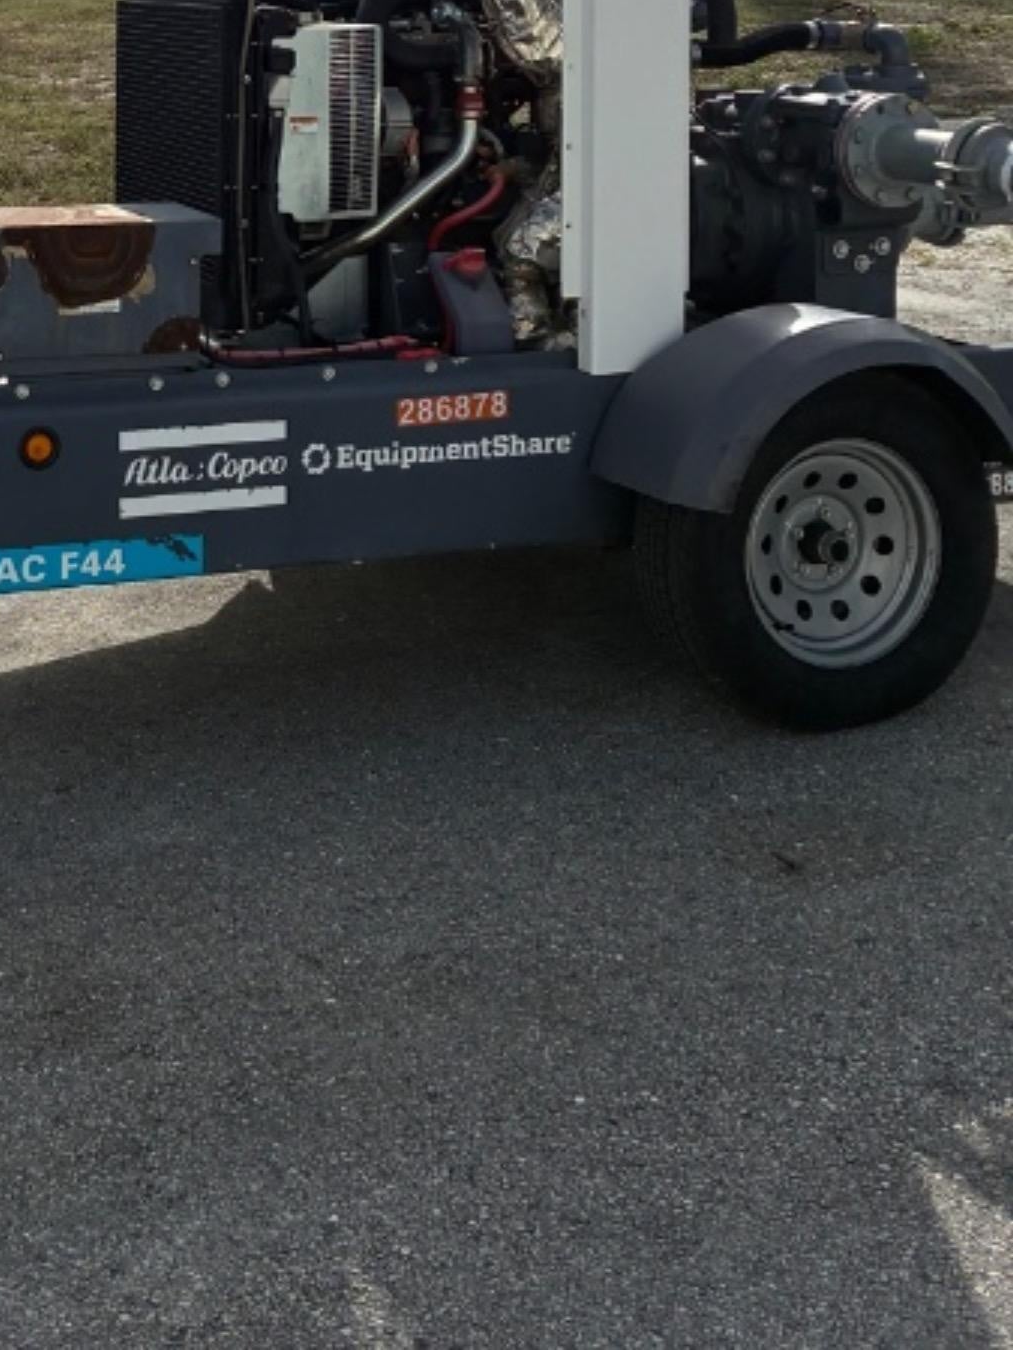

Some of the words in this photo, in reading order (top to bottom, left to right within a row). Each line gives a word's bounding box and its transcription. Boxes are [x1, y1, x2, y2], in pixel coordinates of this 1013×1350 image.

[397, 390, 508, 426] 286878
[207, 451, 288, 484] Copco
[336, 434, 572, 472] EquipmentShare
[60, 548, 126, 580] F44
